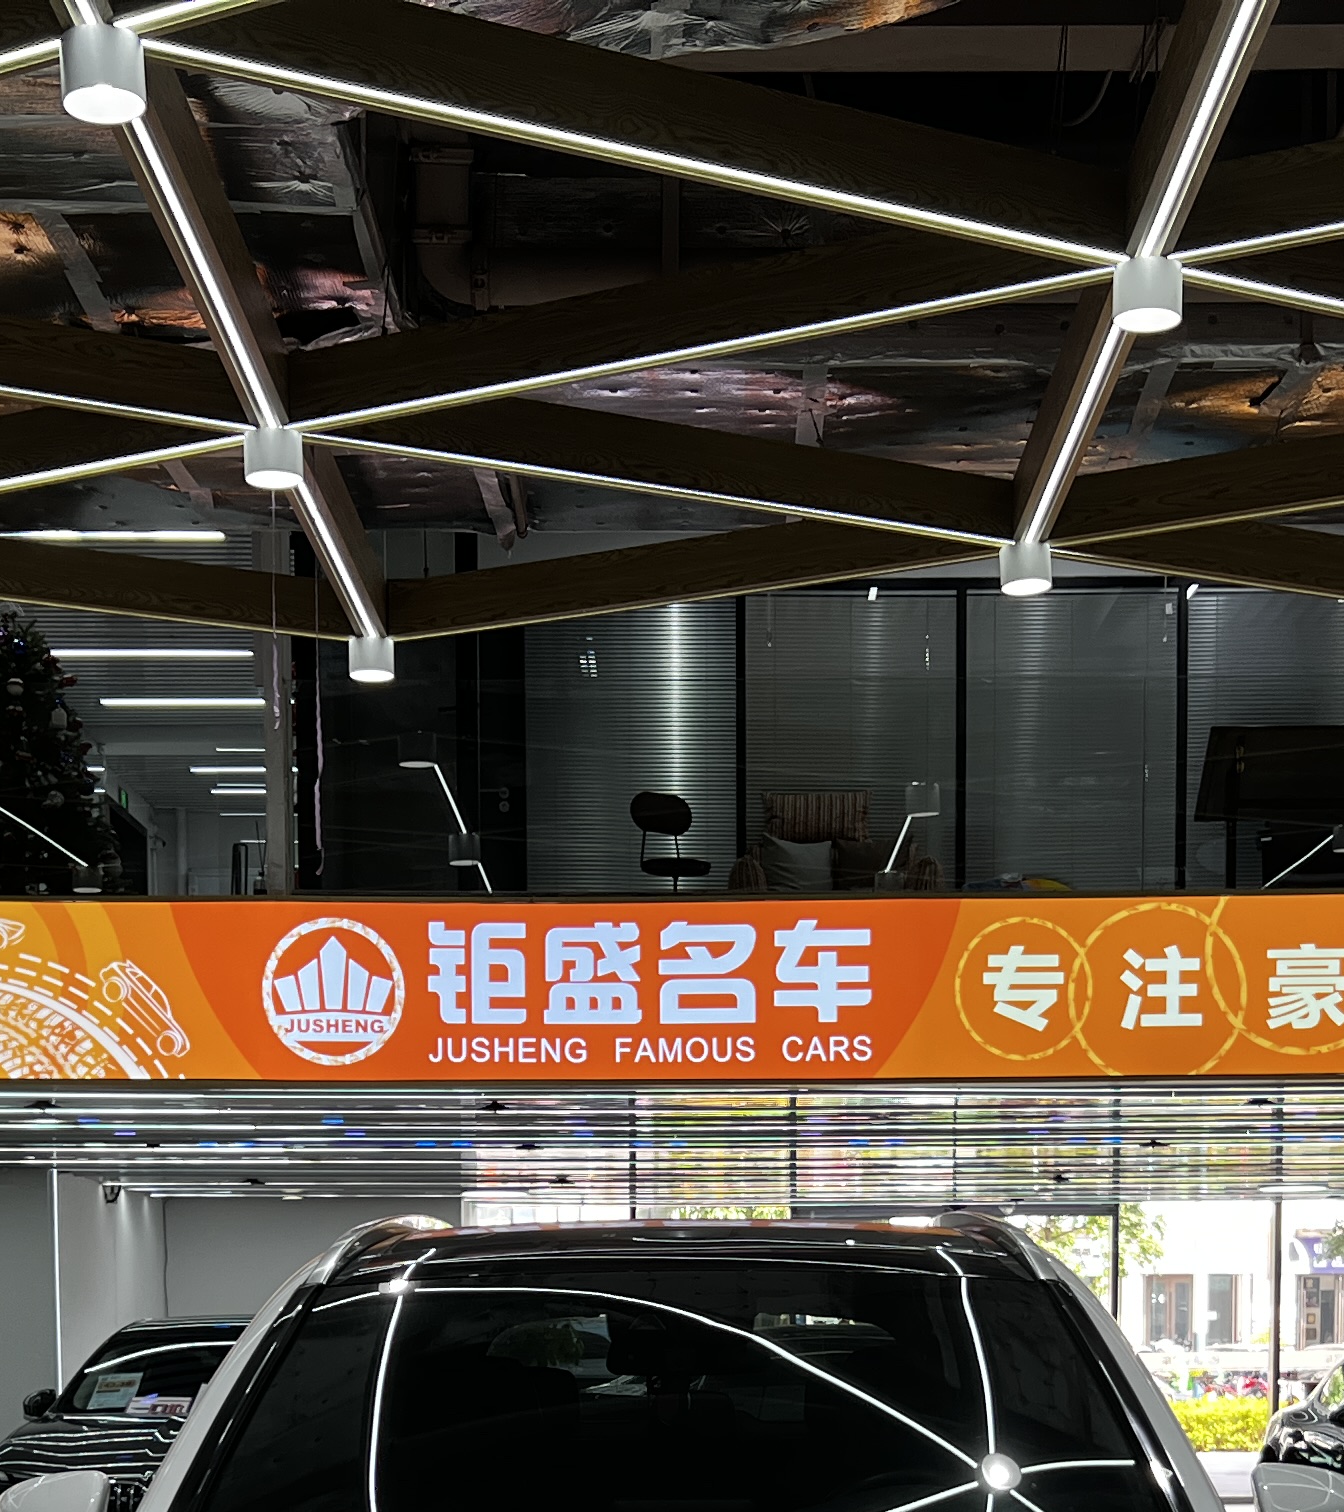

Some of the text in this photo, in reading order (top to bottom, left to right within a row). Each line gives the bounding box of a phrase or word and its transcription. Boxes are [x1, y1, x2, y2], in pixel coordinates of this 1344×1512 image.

[428, 919, 873, 1025] 钜盛名车
[284, 1018, 386, 1034] JUSHENG
[428, 1035, 873, 1063] JUSHENG FAMOUS CARS
